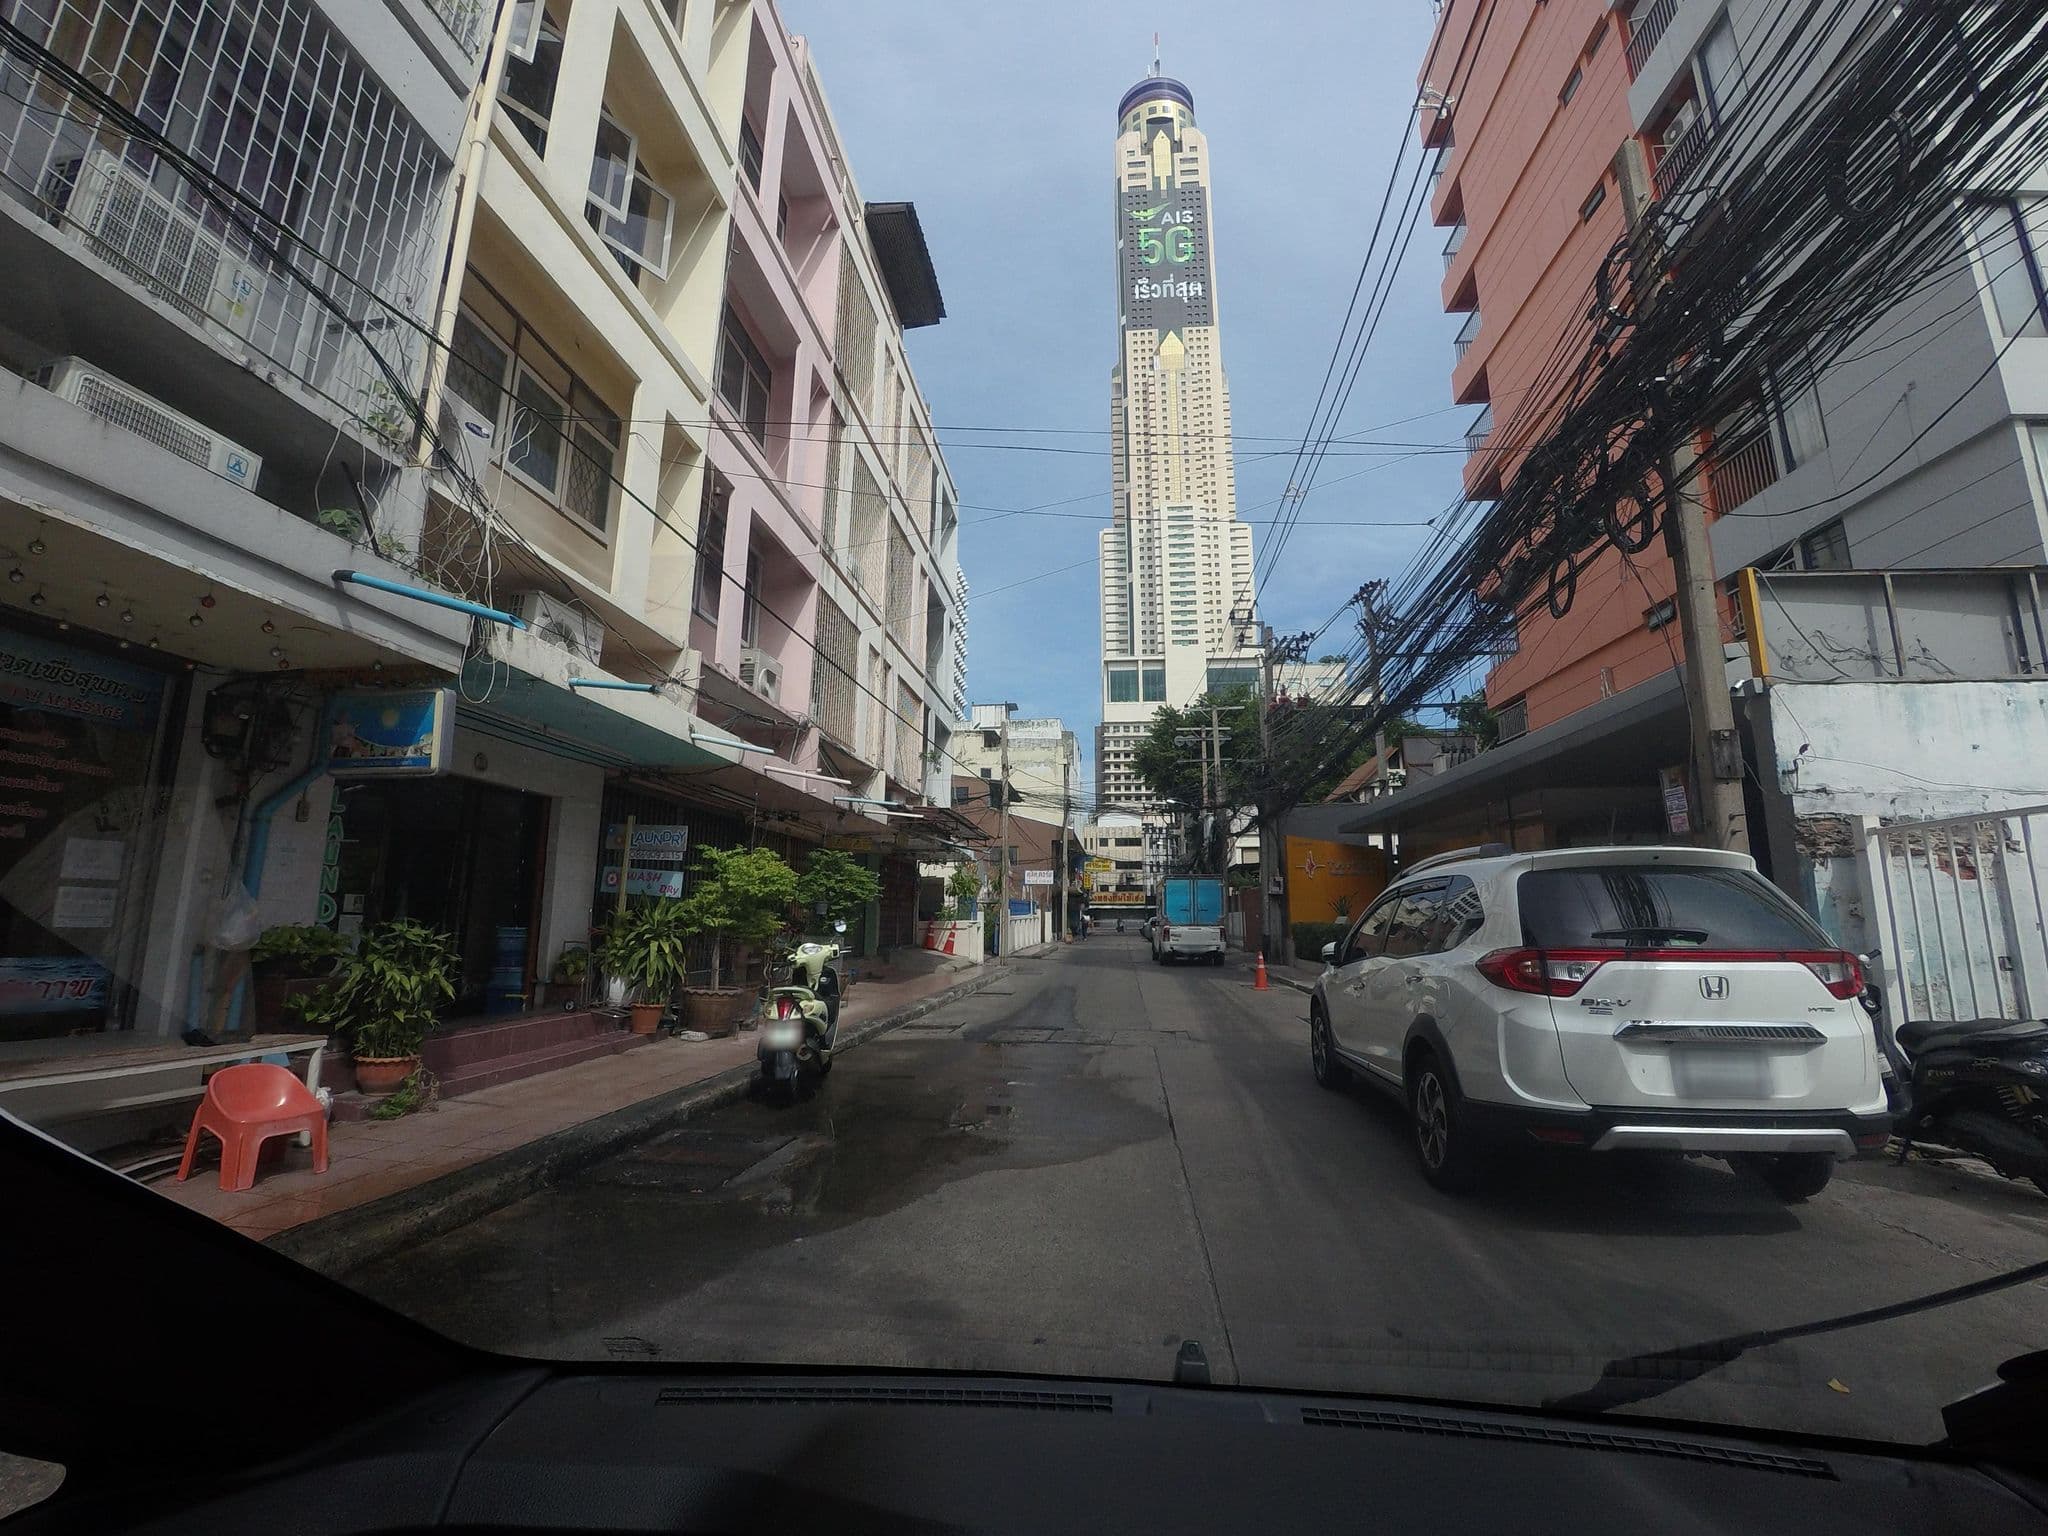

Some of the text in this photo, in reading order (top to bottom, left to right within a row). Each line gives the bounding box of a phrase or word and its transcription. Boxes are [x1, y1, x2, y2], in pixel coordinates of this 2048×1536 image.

[1160, 210, 1194, 225] AIS
[1138, 225, 1195, 265] 5G
[1134, 273, 1203, 303] เร็วที่สุด
[630, 830, 687, 847] LAUNDRY
[627, 871, 663, 882] WASH
[1580, 998, 1632, 1007] BR-V
